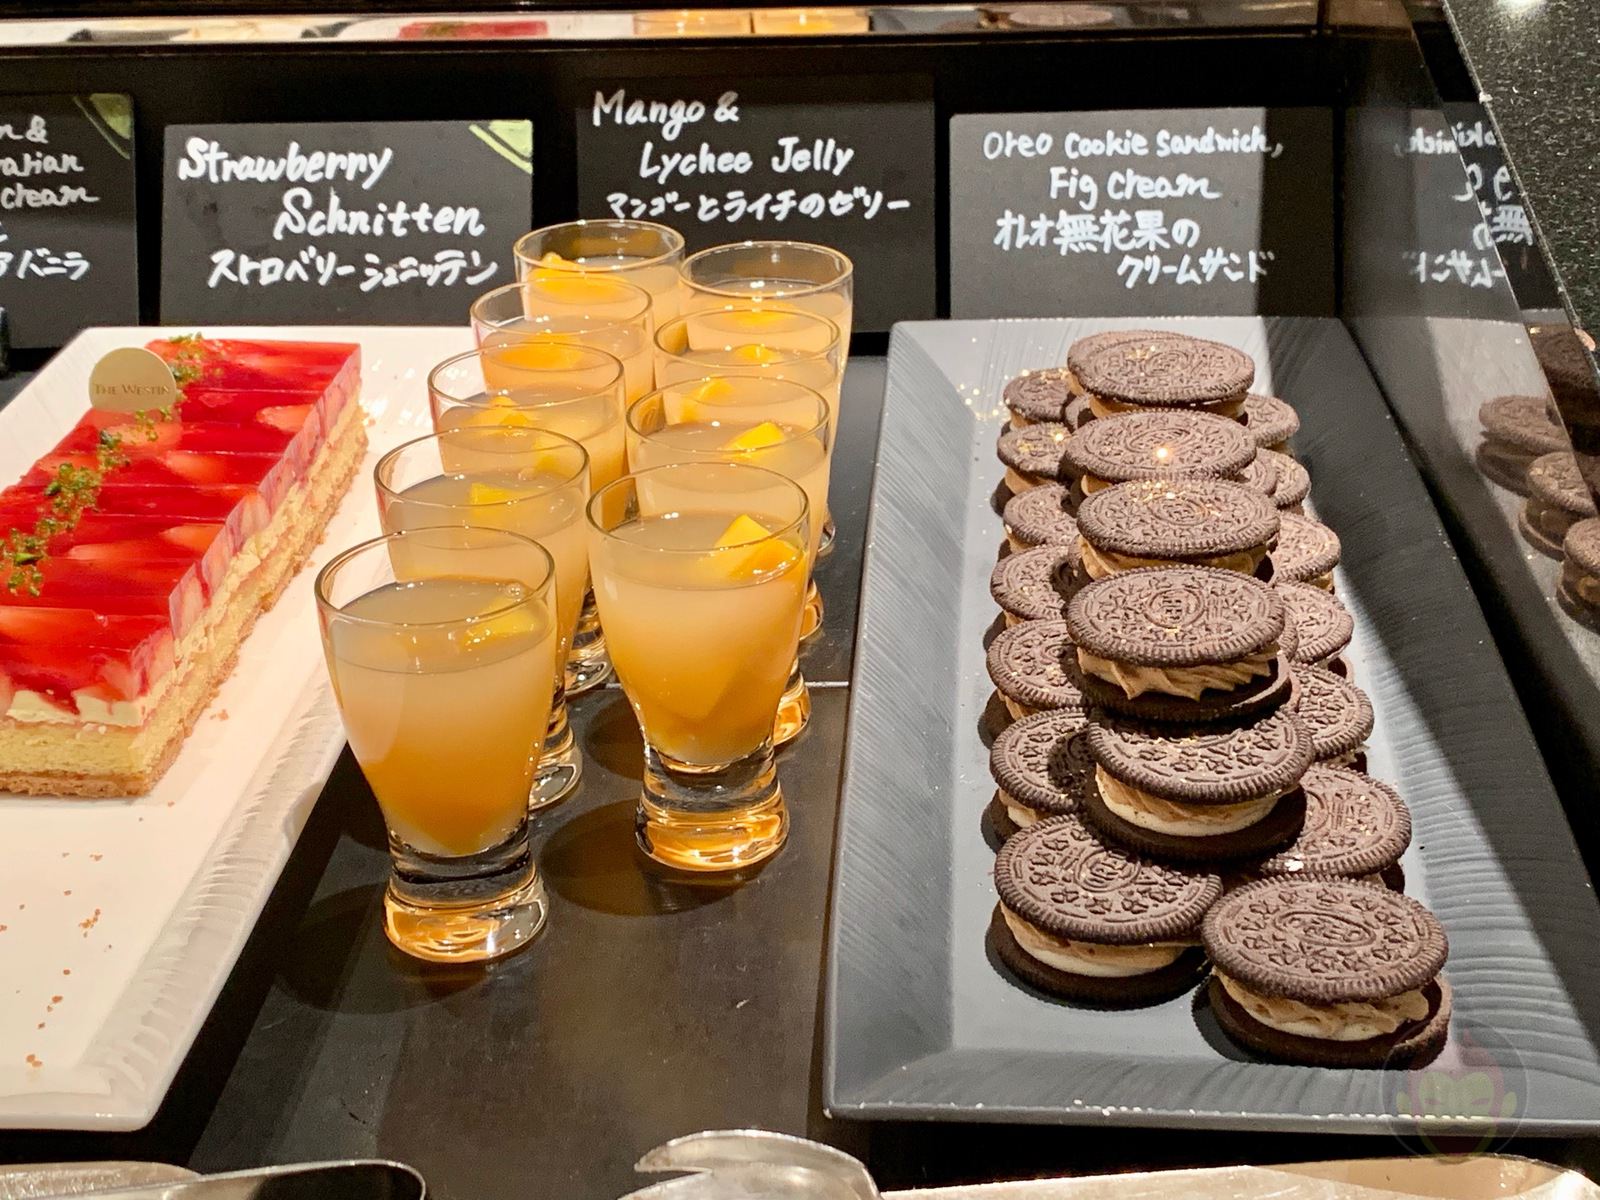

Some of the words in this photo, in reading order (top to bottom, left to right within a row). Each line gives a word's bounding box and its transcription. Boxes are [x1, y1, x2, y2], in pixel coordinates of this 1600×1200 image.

[25, 114, 49, 144] &
[593, 89, 705, 141] Mango
[713, 92, 740, 123] &
[0, 151, 85, 177] arian
[178, 137, 392, 190] Strawberry
[640, 141, 753, 185] Lychee
[771, 136, 855, 177] Jelly
[983, 130, 1053, 160] Oreo
[1064, 129, 1149, 160] Cookie
[606, 186, 911, 222] マンゴーとライチのゼリー
[1050, 166, 1098, 211] Fig
[273, 186, 486, 241] Schnitten
[993, 208, 1201, 256] オレオ無花果の
[1117, 246, 1276, 289] クリームサンド
[95, 383, 117, 396] THE
